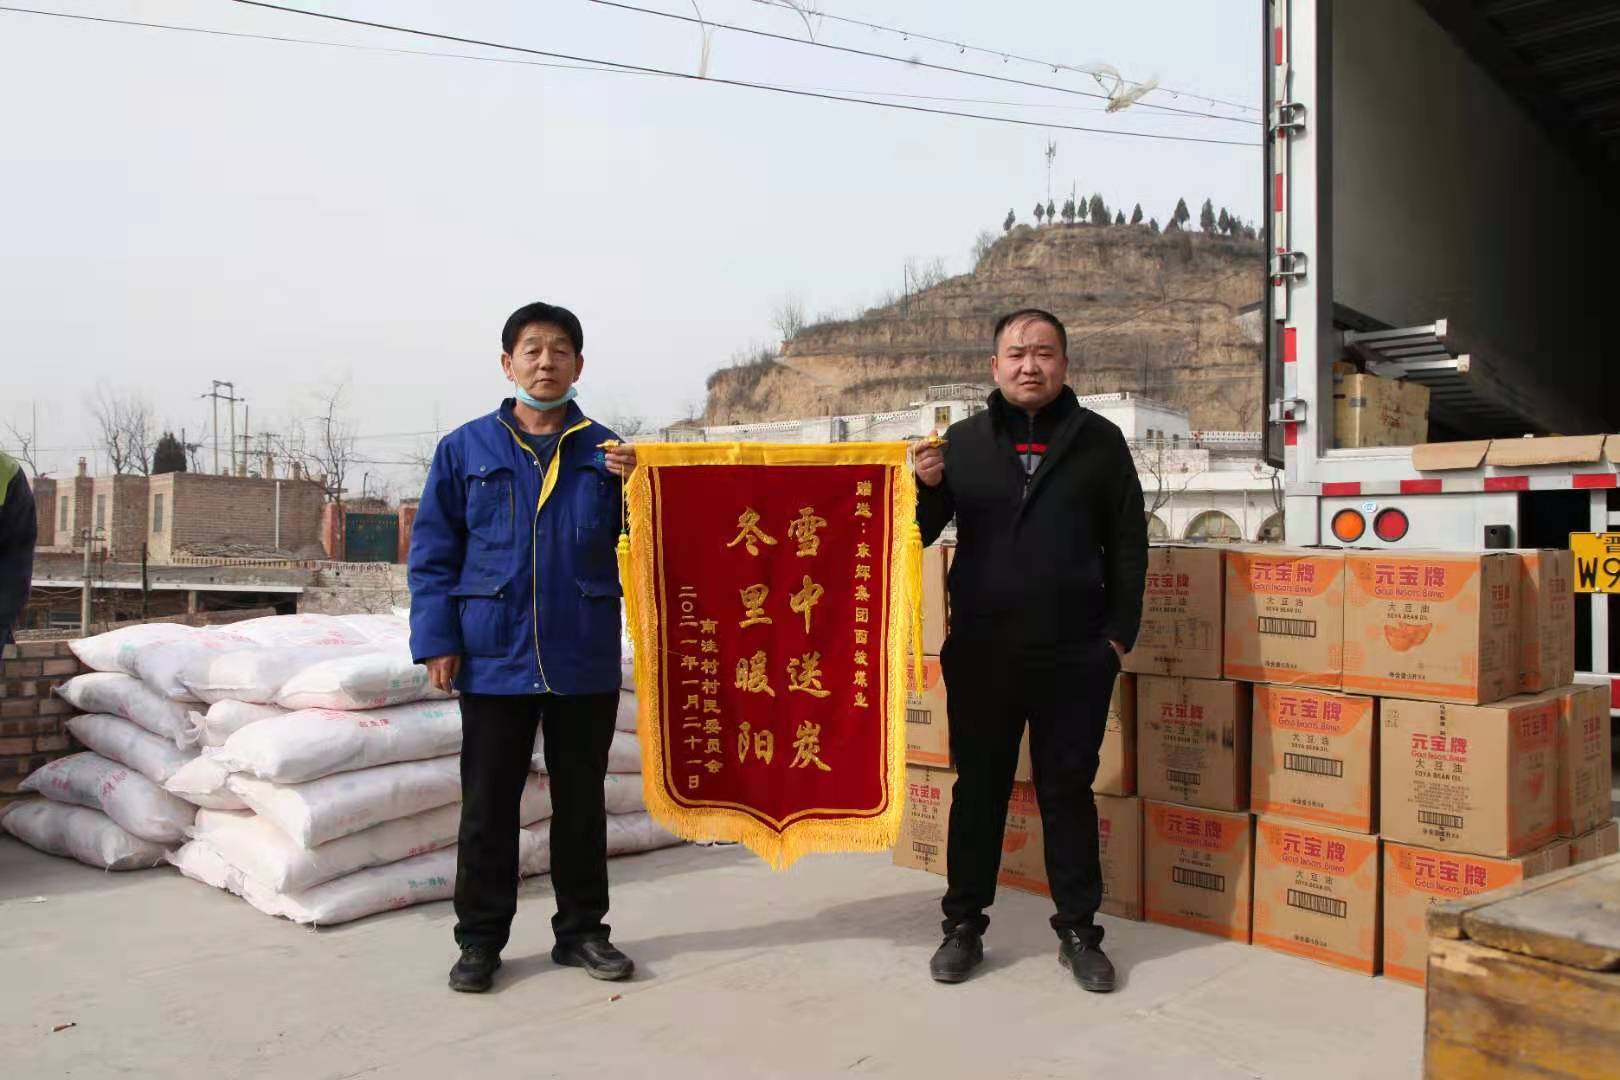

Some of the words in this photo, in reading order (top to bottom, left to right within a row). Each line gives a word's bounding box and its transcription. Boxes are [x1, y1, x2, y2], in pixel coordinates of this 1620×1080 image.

[1254, 561, 1315, 583] 元宝牌
[1375, 565, 1445, 587] 元宝牌
[1388, 602, 1430, 613] 大豆油
[727, 505, 778, 765] 冬里暖阳
[787, 506, 832, 772] 雪中送炭
[1279, 696, 1342, 722] 元宝牌
[1411, 733, 1467, 754] 元宝牌
[1415, 759, 1462, 774] 大豆油
[1167, 813, 1222, 839] 元宝牌
[1283, 832, 1346, 862] 元宝牌
[1415, 856, 1487, 888] 元宝牌
